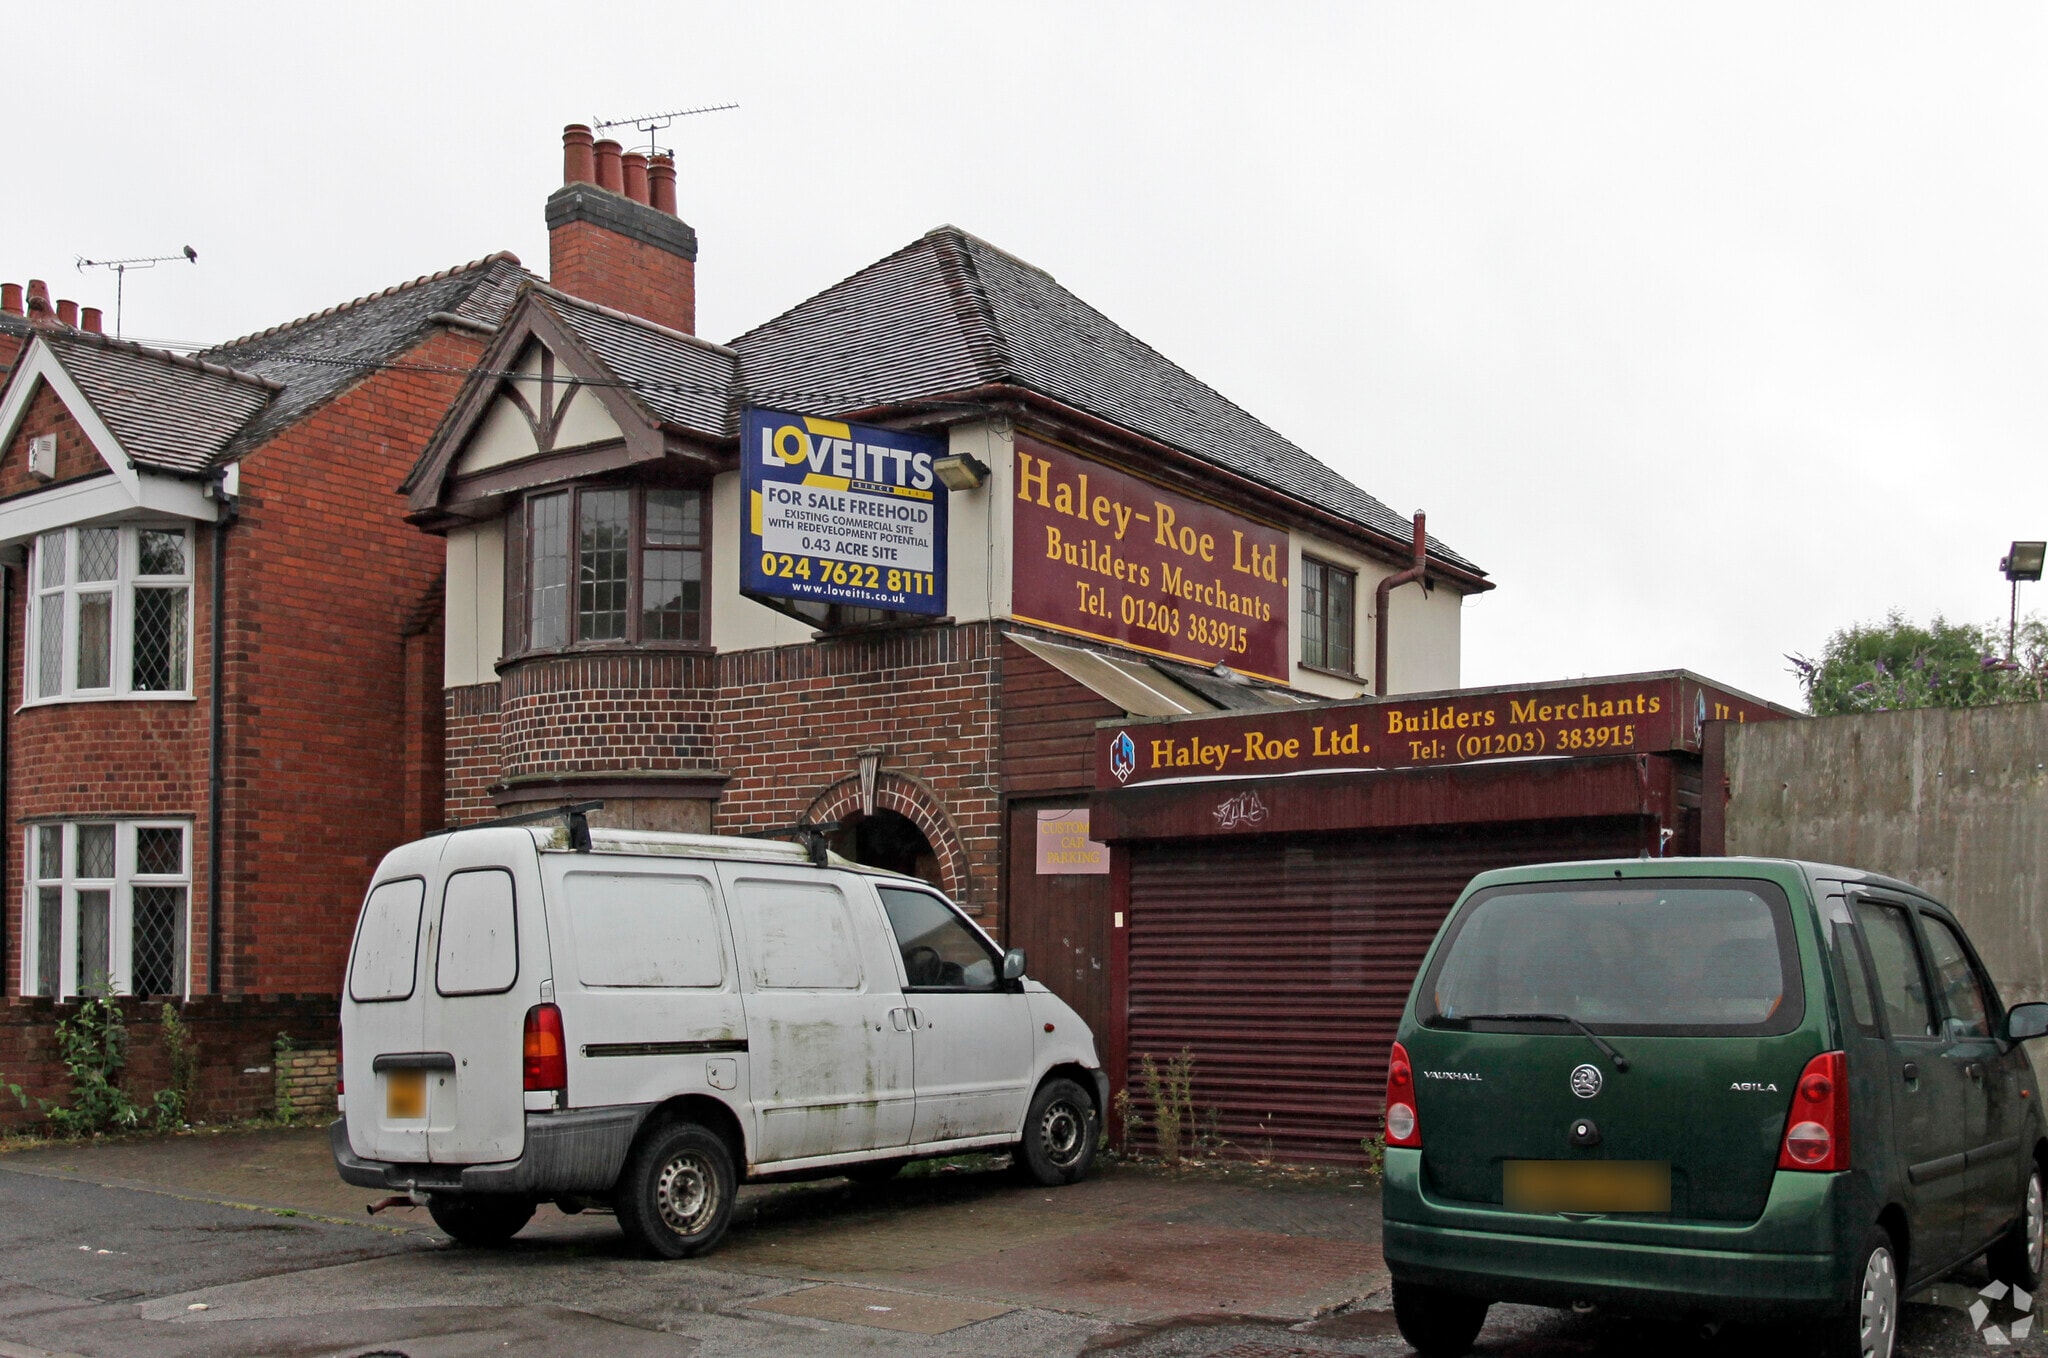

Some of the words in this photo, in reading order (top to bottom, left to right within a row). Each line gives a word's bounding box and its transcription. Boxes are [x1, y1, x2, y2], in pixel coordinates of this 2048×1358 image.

[762, 425, 934, 490] LOVEITTS
[769, 487, 802, 506] FOR
[808, 493, 845, 512] SALE
[850, 499, 928, 524] FREEHOLD
[785, 509, 830, 523] EXISTING
[832, 515, 893, 532] COMMERCIAL
[896, 524, 914, 535] SITE
[1018, 452, 1215, 562] Haley-Roe
[1232, 530, 1288, 587] Ltd.
[768, 518, 794, 529] WITH
[797, 521, 877, 541] REDEVELOPMENT
[880, 533, 929, 548] POTENTIAL
[802, 537, 830, 551] 0.43
[835, 541, 868, 557] ACRE
[872, 546, 898, 561] SITE
[761, 553, 811, 580] 024
[819, 561, 879, 588] 7622
[887, 569, 934, 595] 8111
[1046, 525, 1150, 587] Builders
[1161, 562, 1271, 622] Merchants
[792, 582, 905, 604] www.loveitts.co.uk
[1076, 581, 1112, 619] Tel.
[1121, 595, 1180, 636] 01203
[1187, 613, 1247, 654] 383915
[1387, 706, 1495, 734] Builders
[1509, 694, 1661, 724] Merchants
[1151, 731, 1299, 771] Haley-Roe
[1312, 723, 1370, 756] Ltd.
[1409, 739, 1446, 760] Tel:
[1456, 728, 1545, 760] (01203)
[1556, 724, 1635, 750] 383915
[1042, 821, 1090, 835] CUSTOM
[1061, 836, 1085, 848] CAR
[1047, 851, 1101, 865] PARKING
[1423, 1071, 1482, 1080] VAUXHALL
[1730, 1082, 1777, 1092] AGILA
